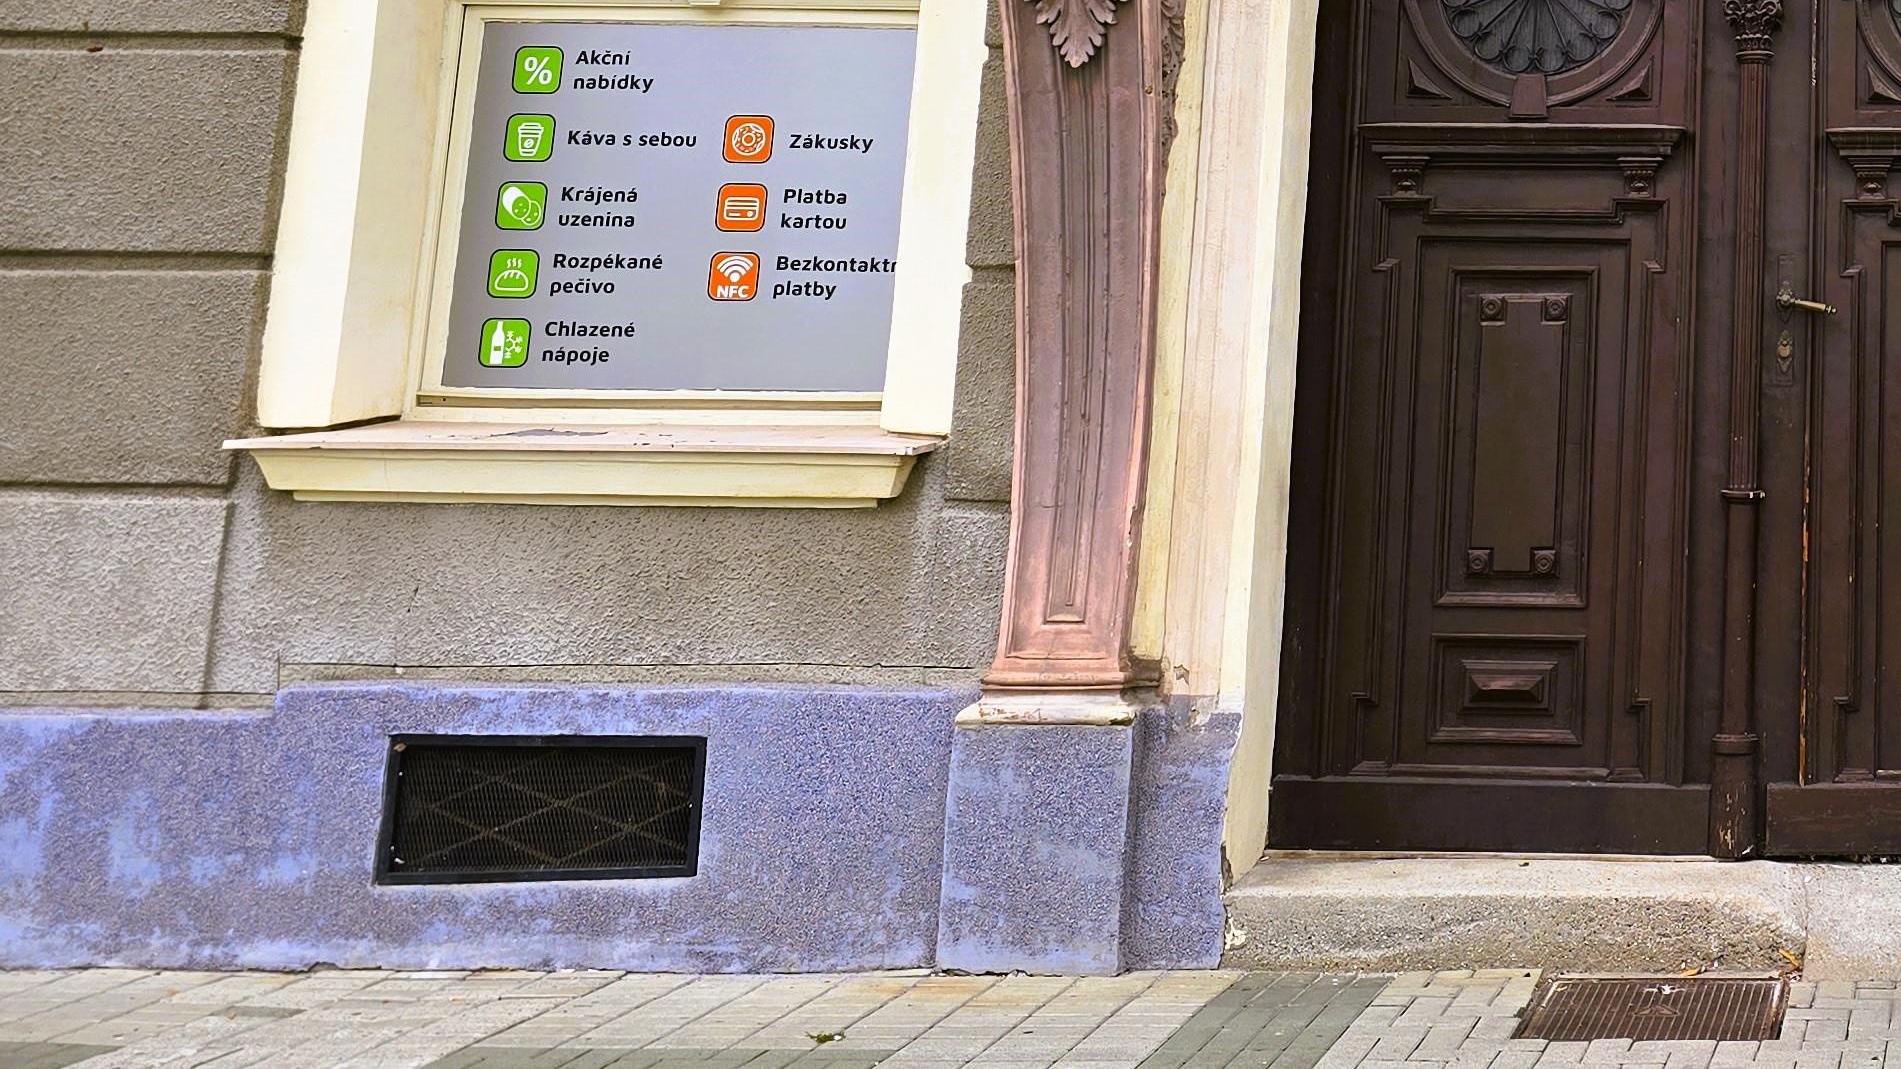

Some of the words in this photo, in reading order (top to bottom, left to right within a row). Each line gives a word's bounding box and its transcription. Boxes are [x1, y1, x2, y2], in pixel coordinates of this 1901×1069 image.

[575, 49, 631, 66] Akční
[573, 74, 654, 93] nabídky
[567, 129, 616, 146] Káva
[622, 134, 632, 147] s
[638, 131, 697, 148] sebou
[789, 133, 874, 153] Zákusky
[561, 186, 638, 205] Krájená
[783, 188, 847, 205] Platba
[558, 211, 635, 228] uzenina
[780, 213, 847, 230] kartou
[552, 253, 663, 273] Rozpékané
[549, 278, 615, 297] pečivo
[716, 285, 750, 299] NFC
[772, 280, 837, 300] platby
[544, 320, 635, 338] Chlazené
[541, 346, 610, 365] nápoje
